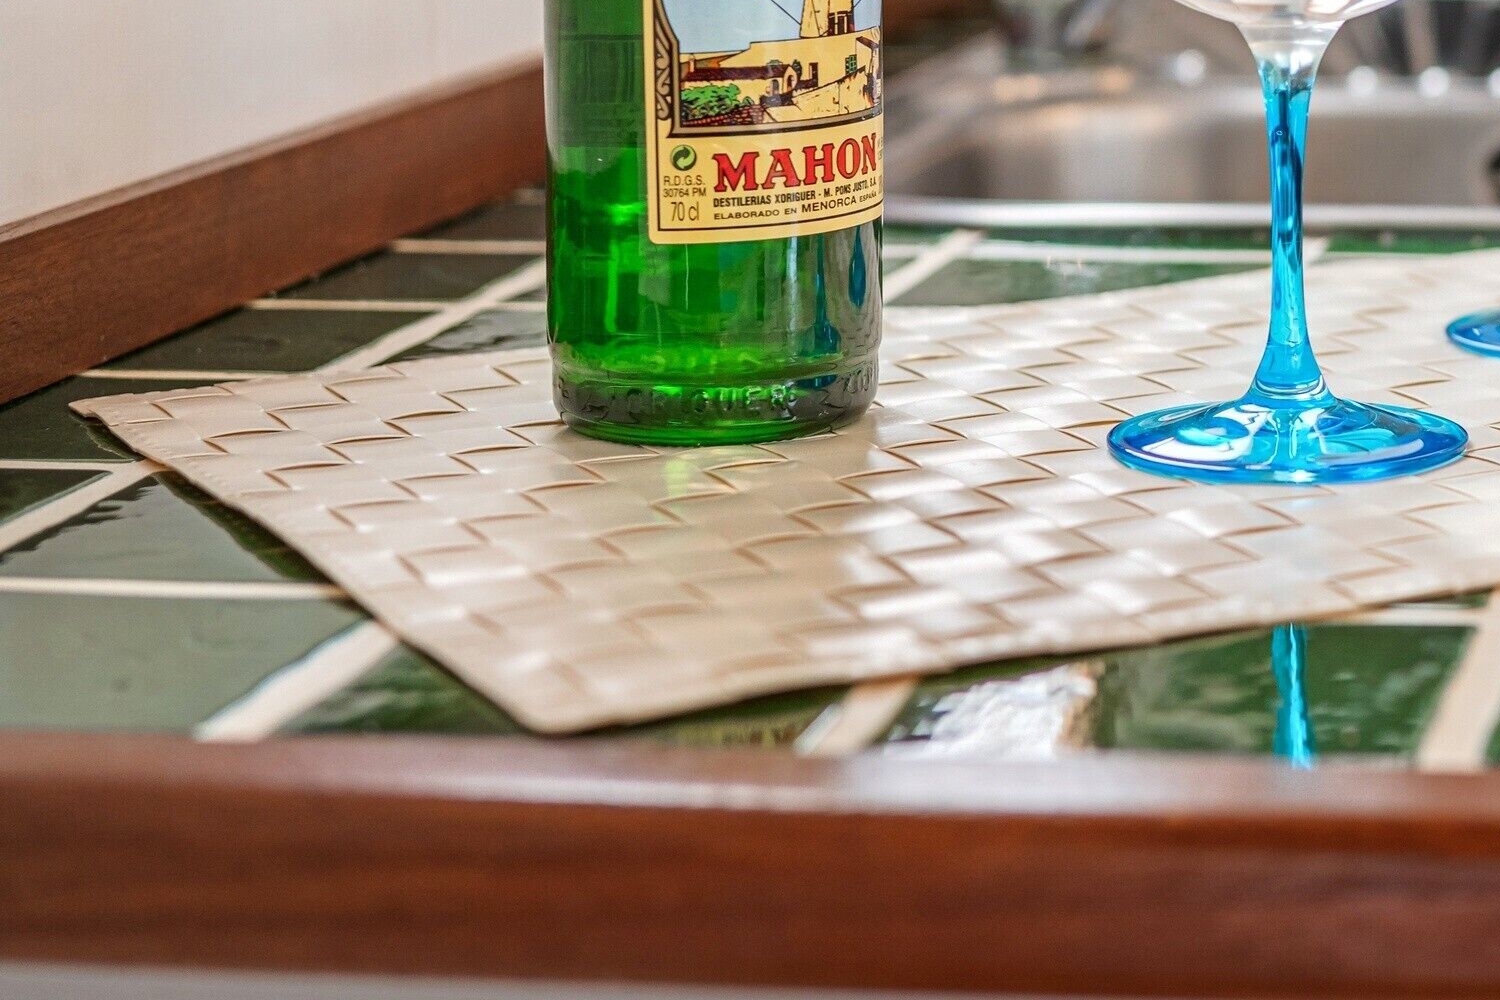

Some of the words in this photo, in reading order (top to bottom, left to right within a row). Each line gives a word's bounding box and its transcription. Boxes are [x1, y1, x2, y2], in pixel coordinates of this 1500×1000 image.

[712, 132, 877, 193] MAHON
[663, 175, 706, 186] R.D.G.S.
[663, 188, 689, 198] 30764
[692, 187, 707, 197] PM
[713, 194, 772, 208] DESTILERIAS
[775, 189, 816, 204] XORIGUER
[824, 187, 833, 198] M.
[835, 183, 851, 196] PONS
[670, 201, 686, 222] 70
[688, 201, 700, 222] cl
[714, 209, 780, 220] ELABORADO
[785, 207, 797, 215] EN
[802, 195, 857, 213] MENORCA
